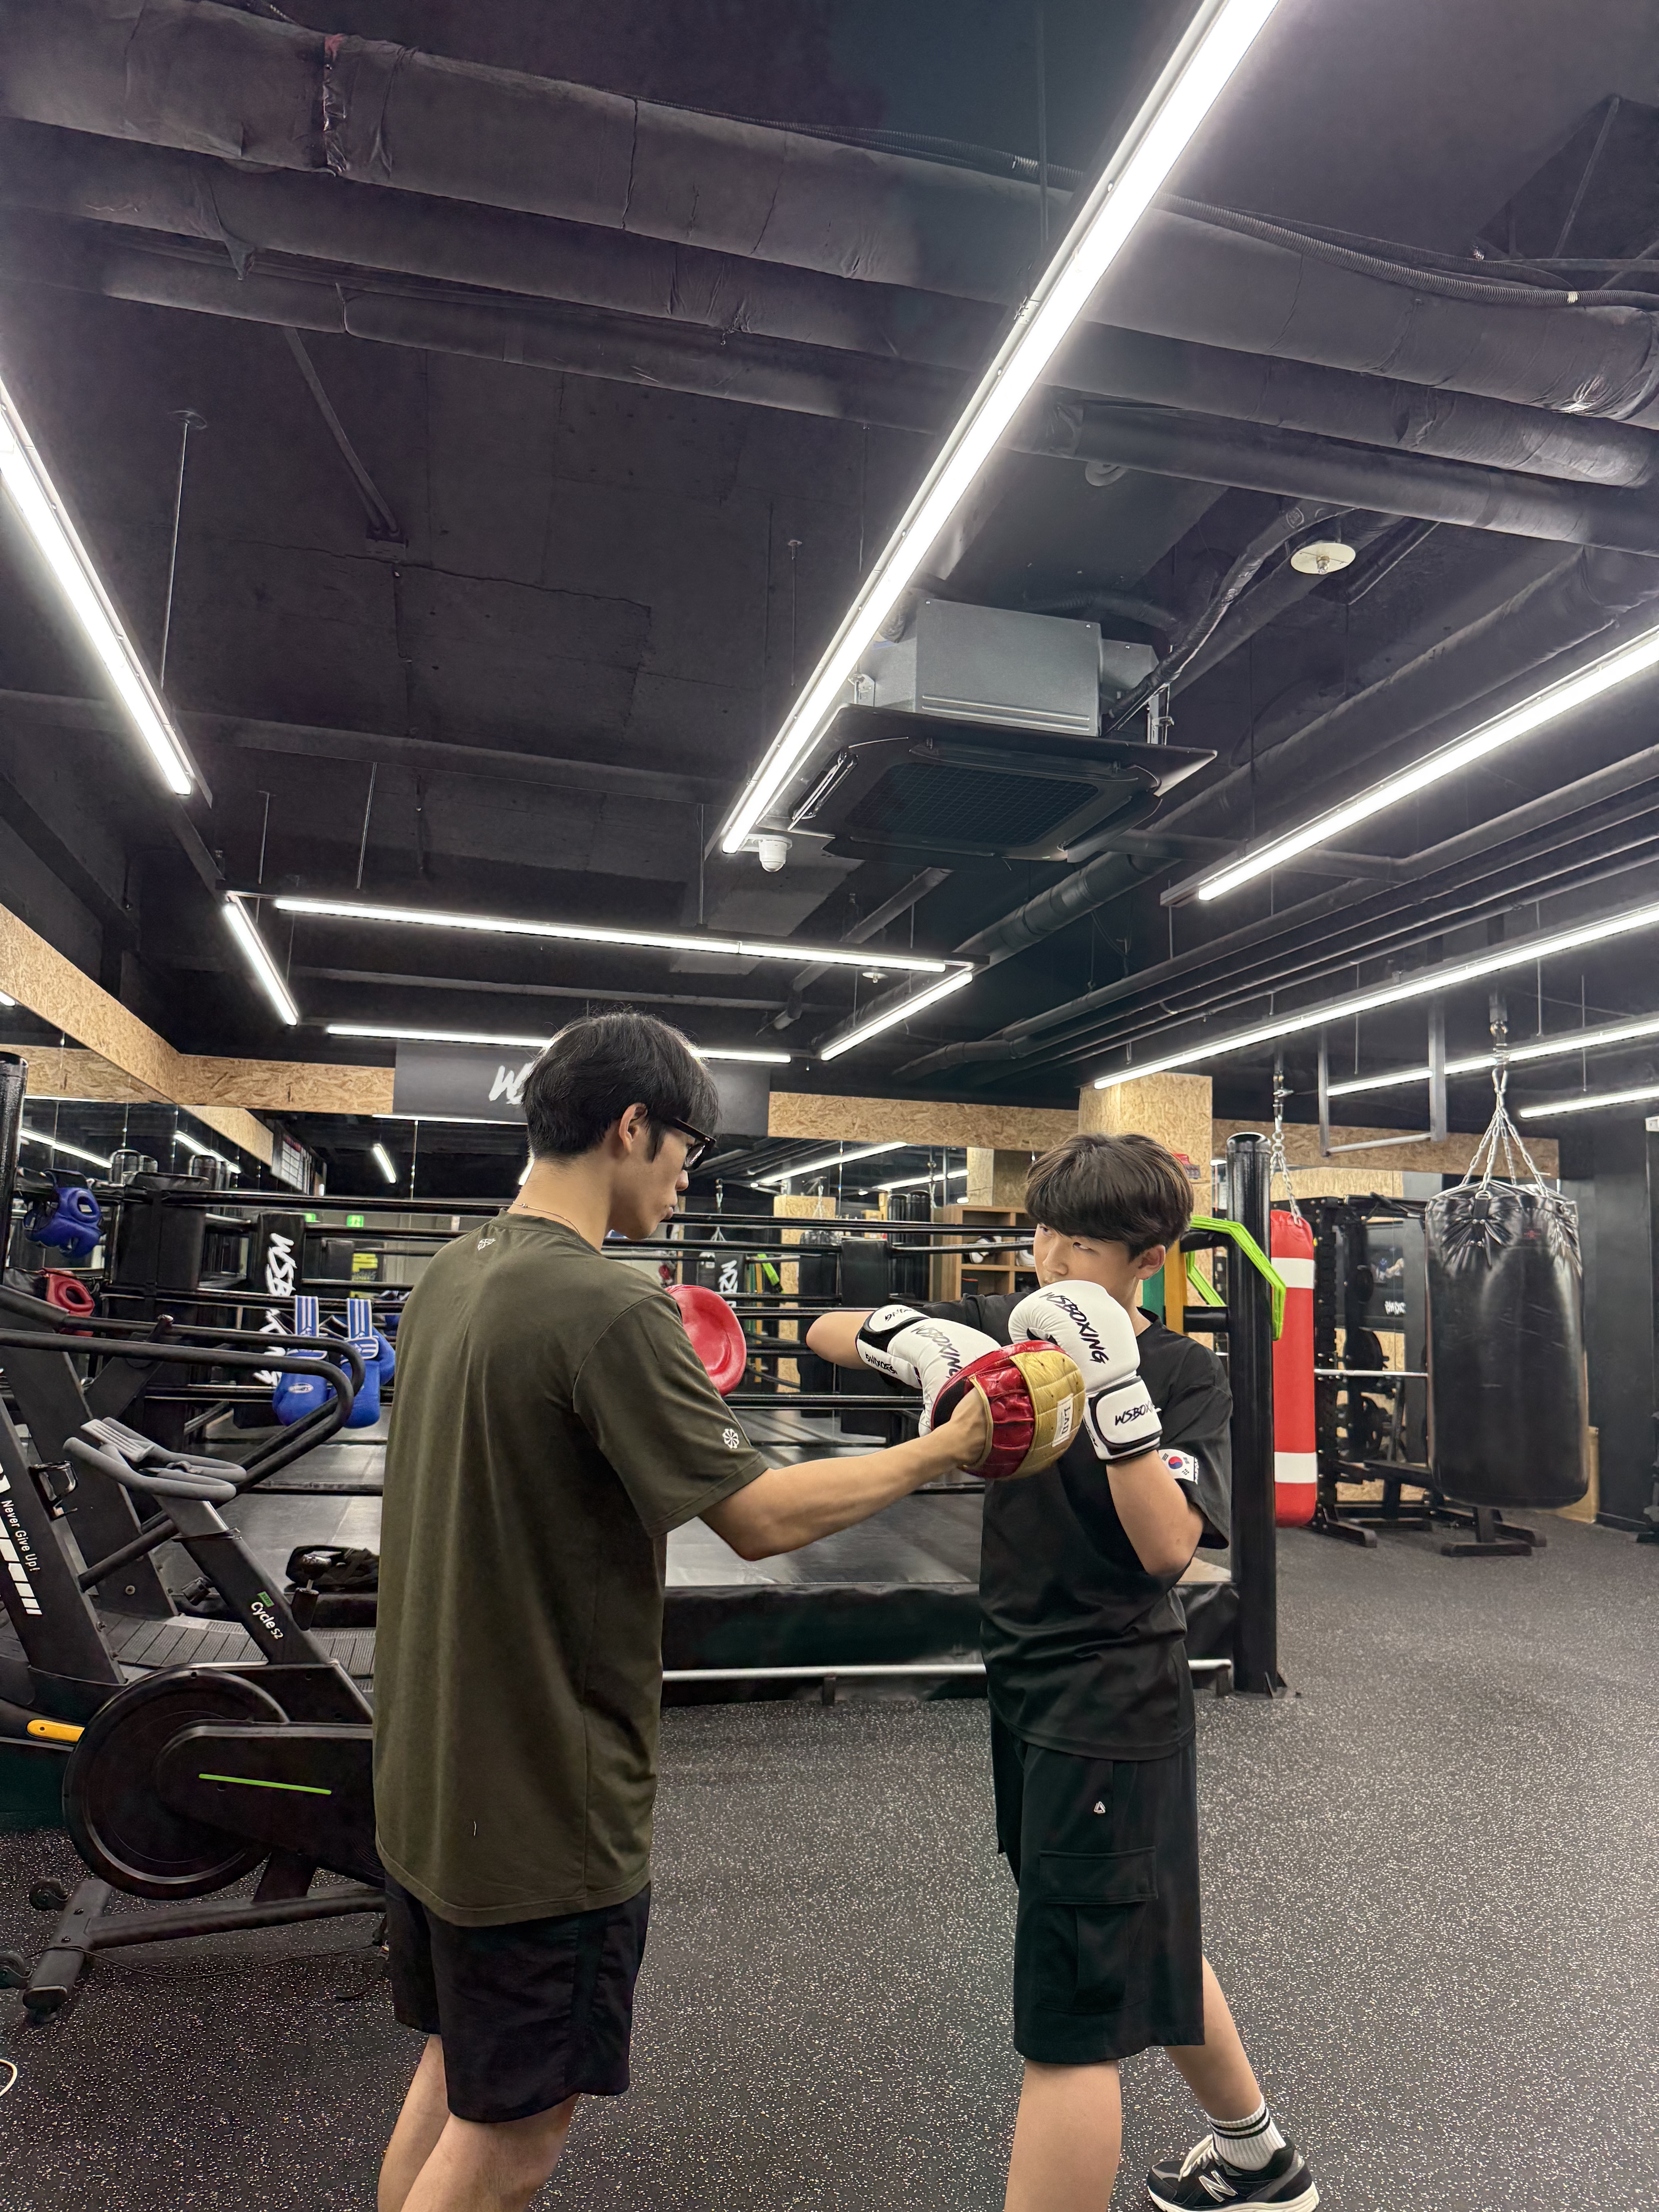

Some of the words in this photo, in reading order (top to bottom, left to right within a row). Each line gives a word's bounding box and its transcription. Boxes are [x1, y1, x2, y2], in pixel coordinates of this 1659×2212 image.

[1039, 1292, 1111, 1364] WSBOXING
[1, 1499, 20, 1528] Never
[15, 1530, 31, 1552] Give
[25, 1553, 41, 1571] Up!
[251, 1601, 276, 1629] Cycle
